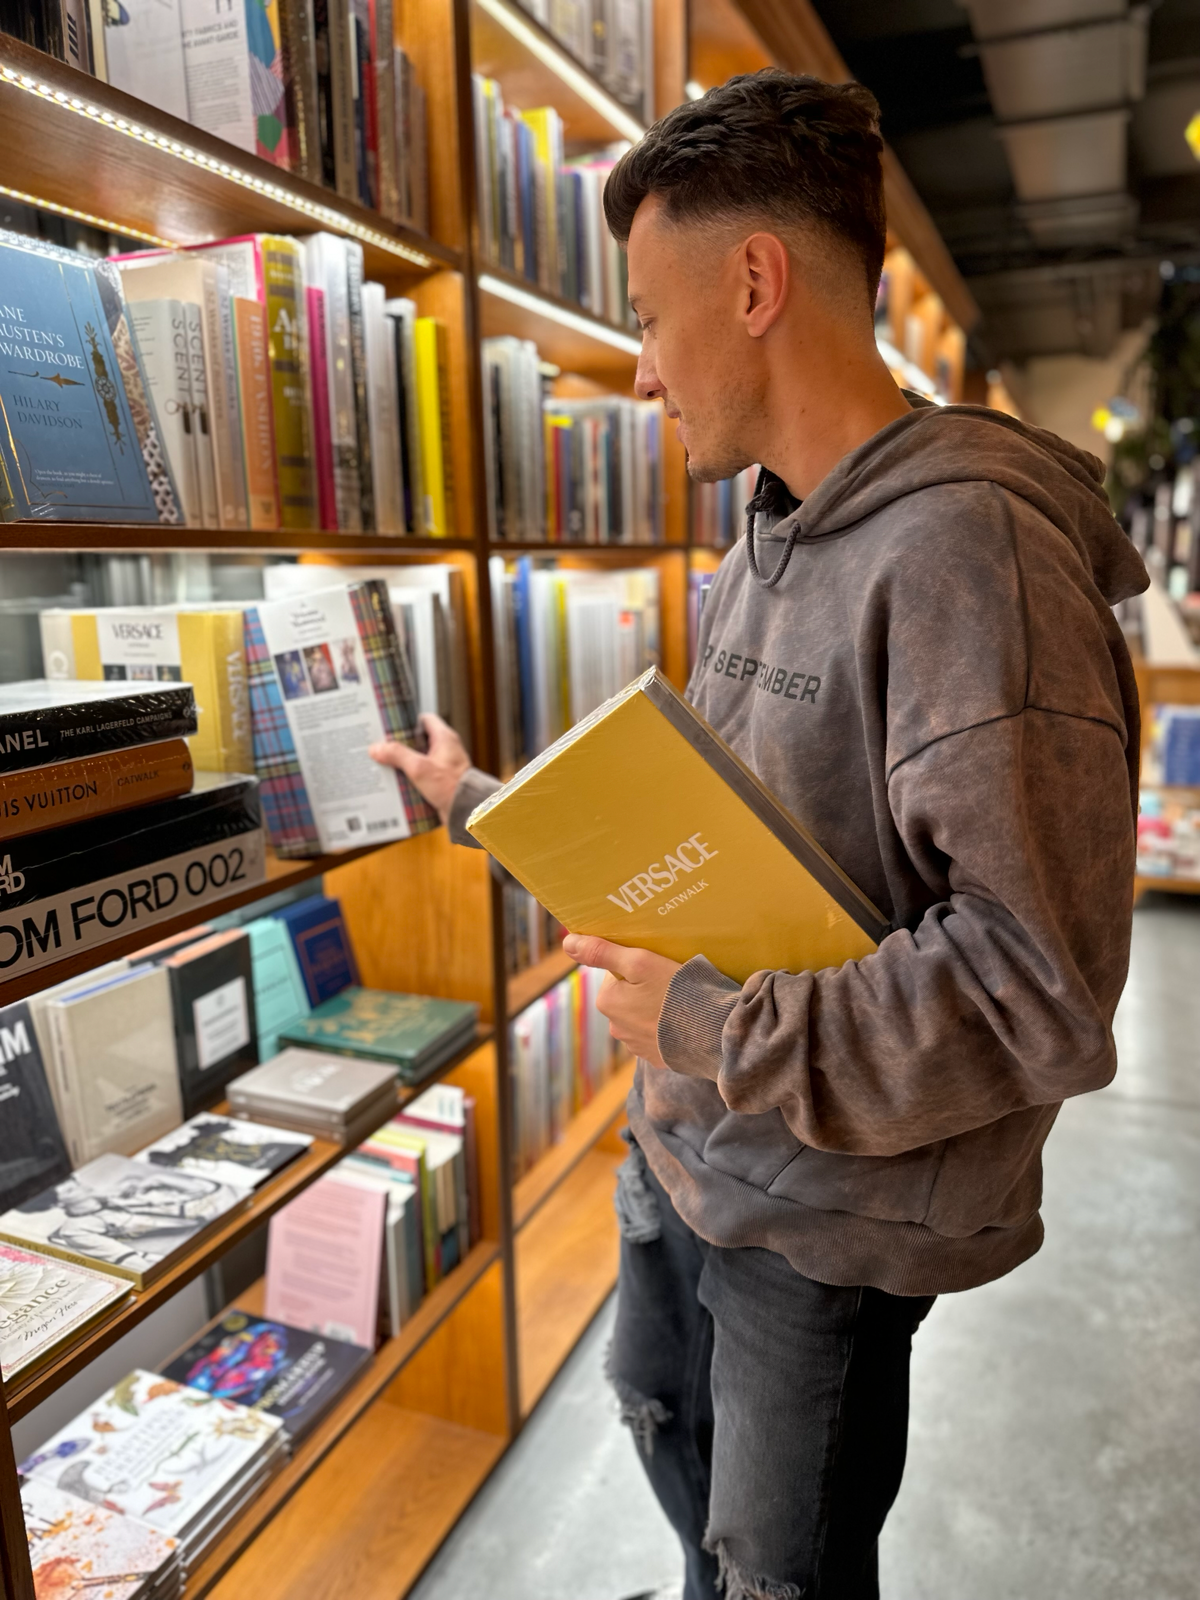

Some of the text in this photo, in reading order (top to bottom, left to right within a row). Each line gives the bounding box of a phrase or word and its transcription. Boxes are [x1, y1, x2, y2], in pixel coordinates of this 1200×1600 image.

[0, 342, 85, 369] WARDROBE
[172, 317, 191, 394] SCENT
[13, 394, 60, 412] HILARY
[17, 411, 83, 430] DAVIDSON
[111, 622, 164, 641] VERSACE
[60, 728, 75, 739] THE
[76, 725, 95, 736] KARL
[97, 717, 135, 732] LAGERFELD
[136, 711, 174, 725] CAMPAIGNS
[0, 769, 160, 818] IS VUITTON CATWALK
[605, 832, 719, 914] VERSACE
[70, 872, 179, 941] FORD
[185, 848, 247, 896] 002
[656, 878, 710, 916] CATWALK
[18, 1316, 57, 1342] Megan
